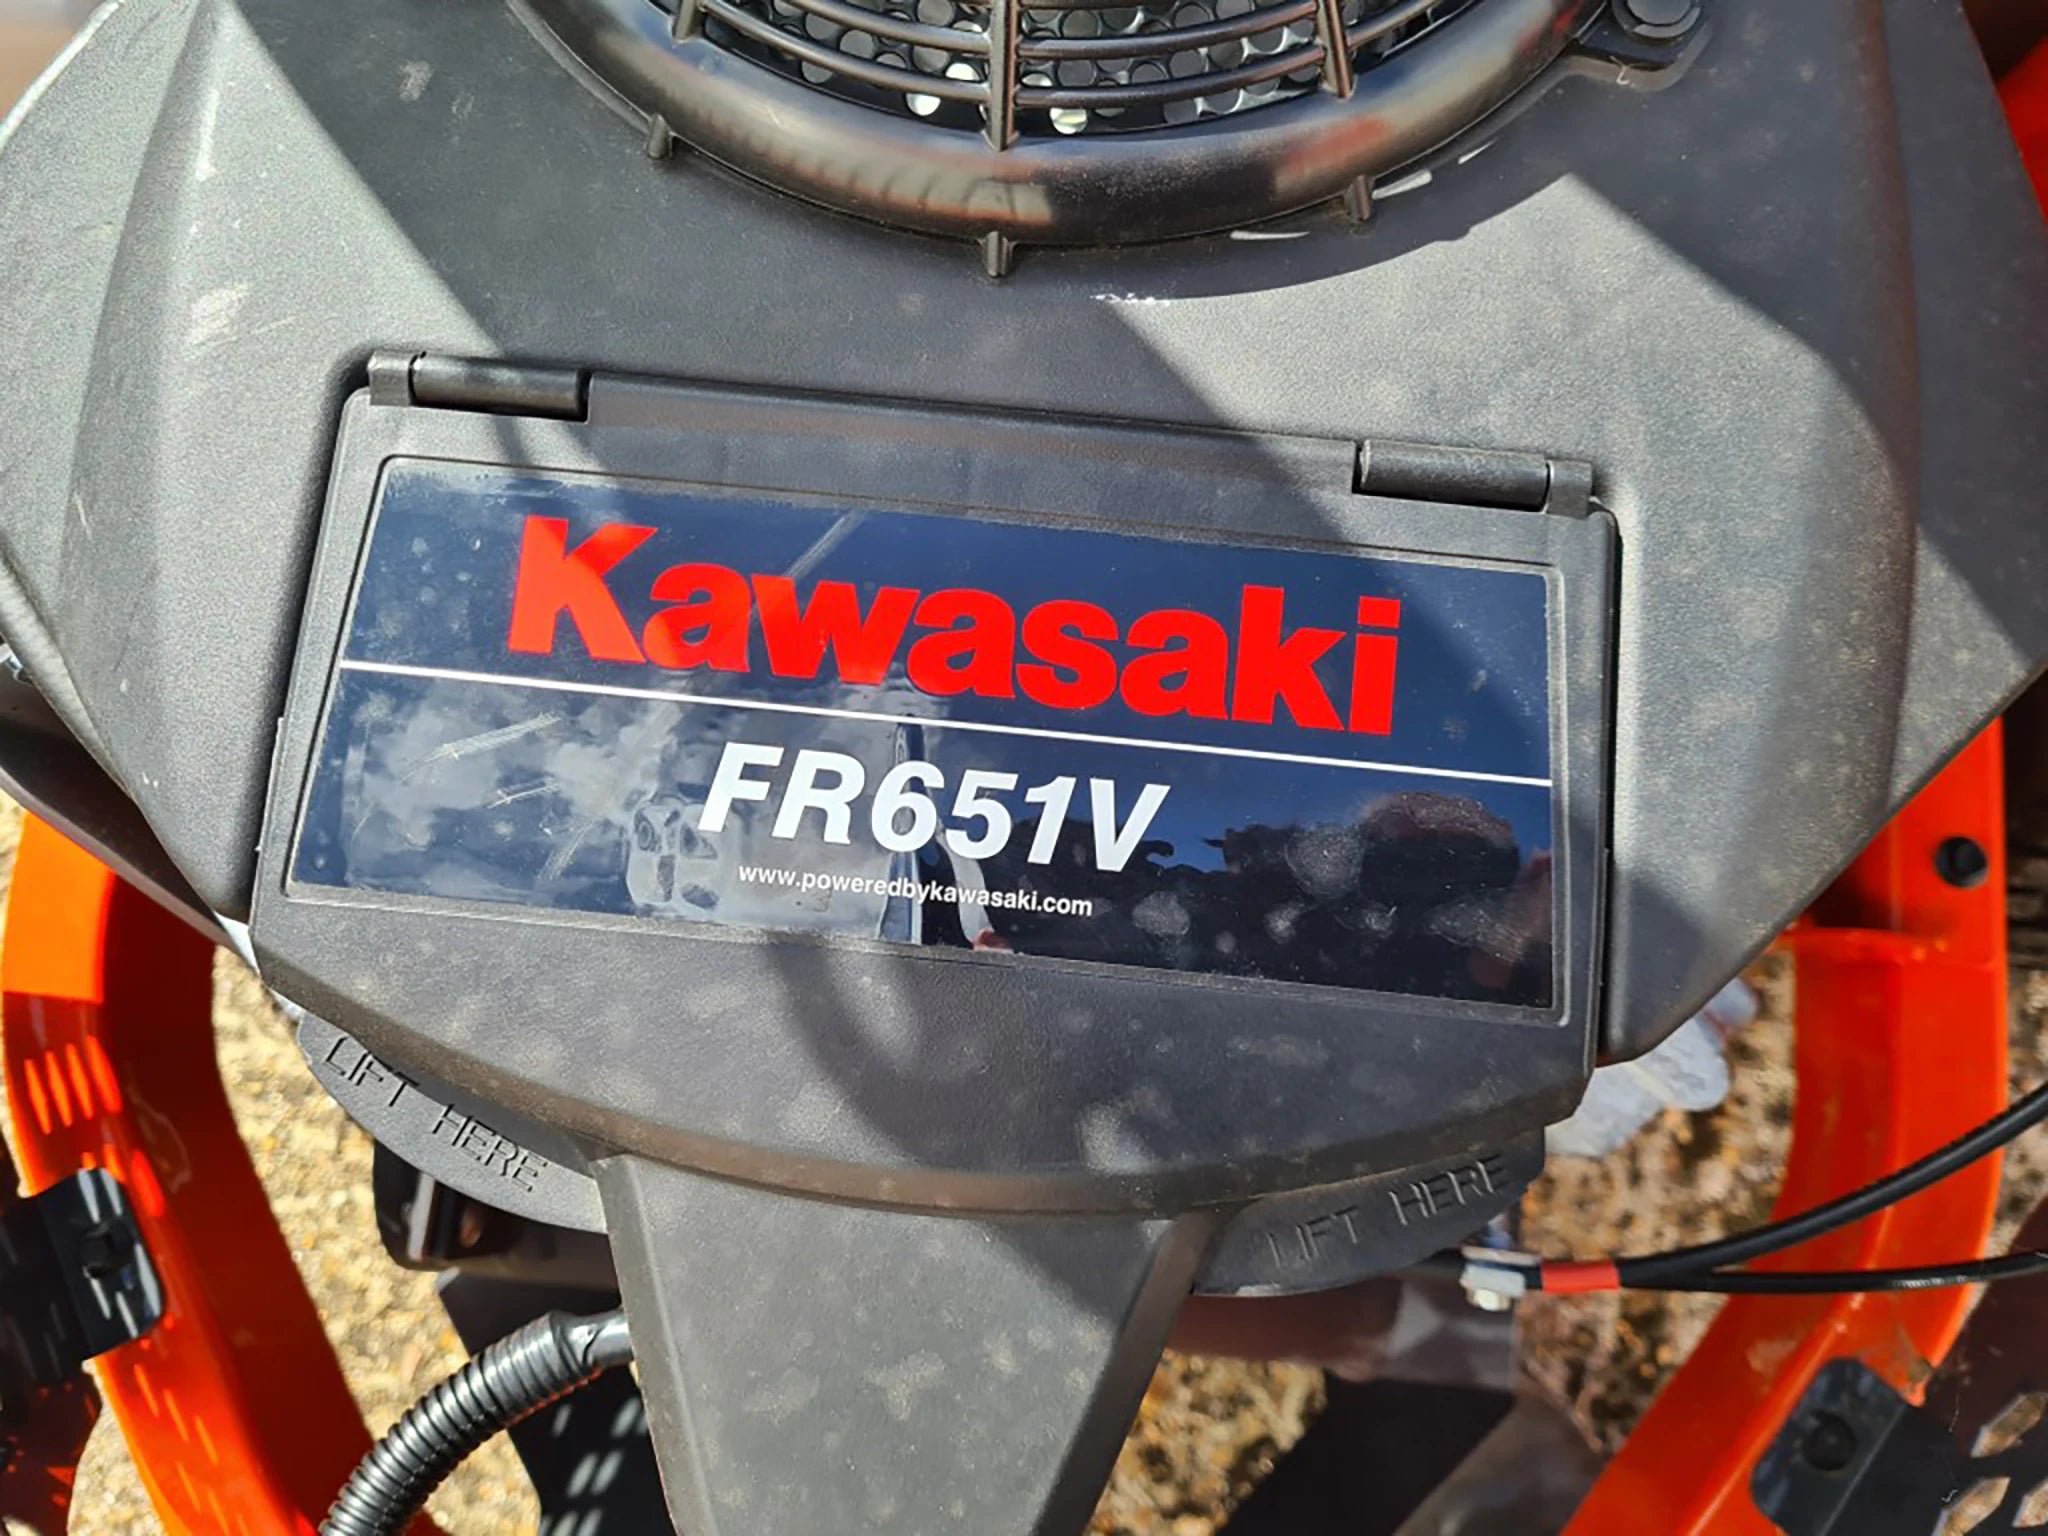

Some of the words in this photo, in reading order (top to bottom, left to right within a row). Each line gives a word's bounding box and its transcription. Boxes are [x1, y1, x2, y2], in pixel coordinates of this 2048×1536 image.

[507, 515, 1402, 736] Kawasaki
[697, 742, 1170, 873] FR651V
[738, 864, 1093, 917] www.poweredbykawasaki.com
[323, 1036, 420, 1107] LIFT
[431, 1103, 549, 1192] HERE
[1266, 1204, 1358, 1268] LIFT
[1388, 1153, 1505, 1226] HERE
